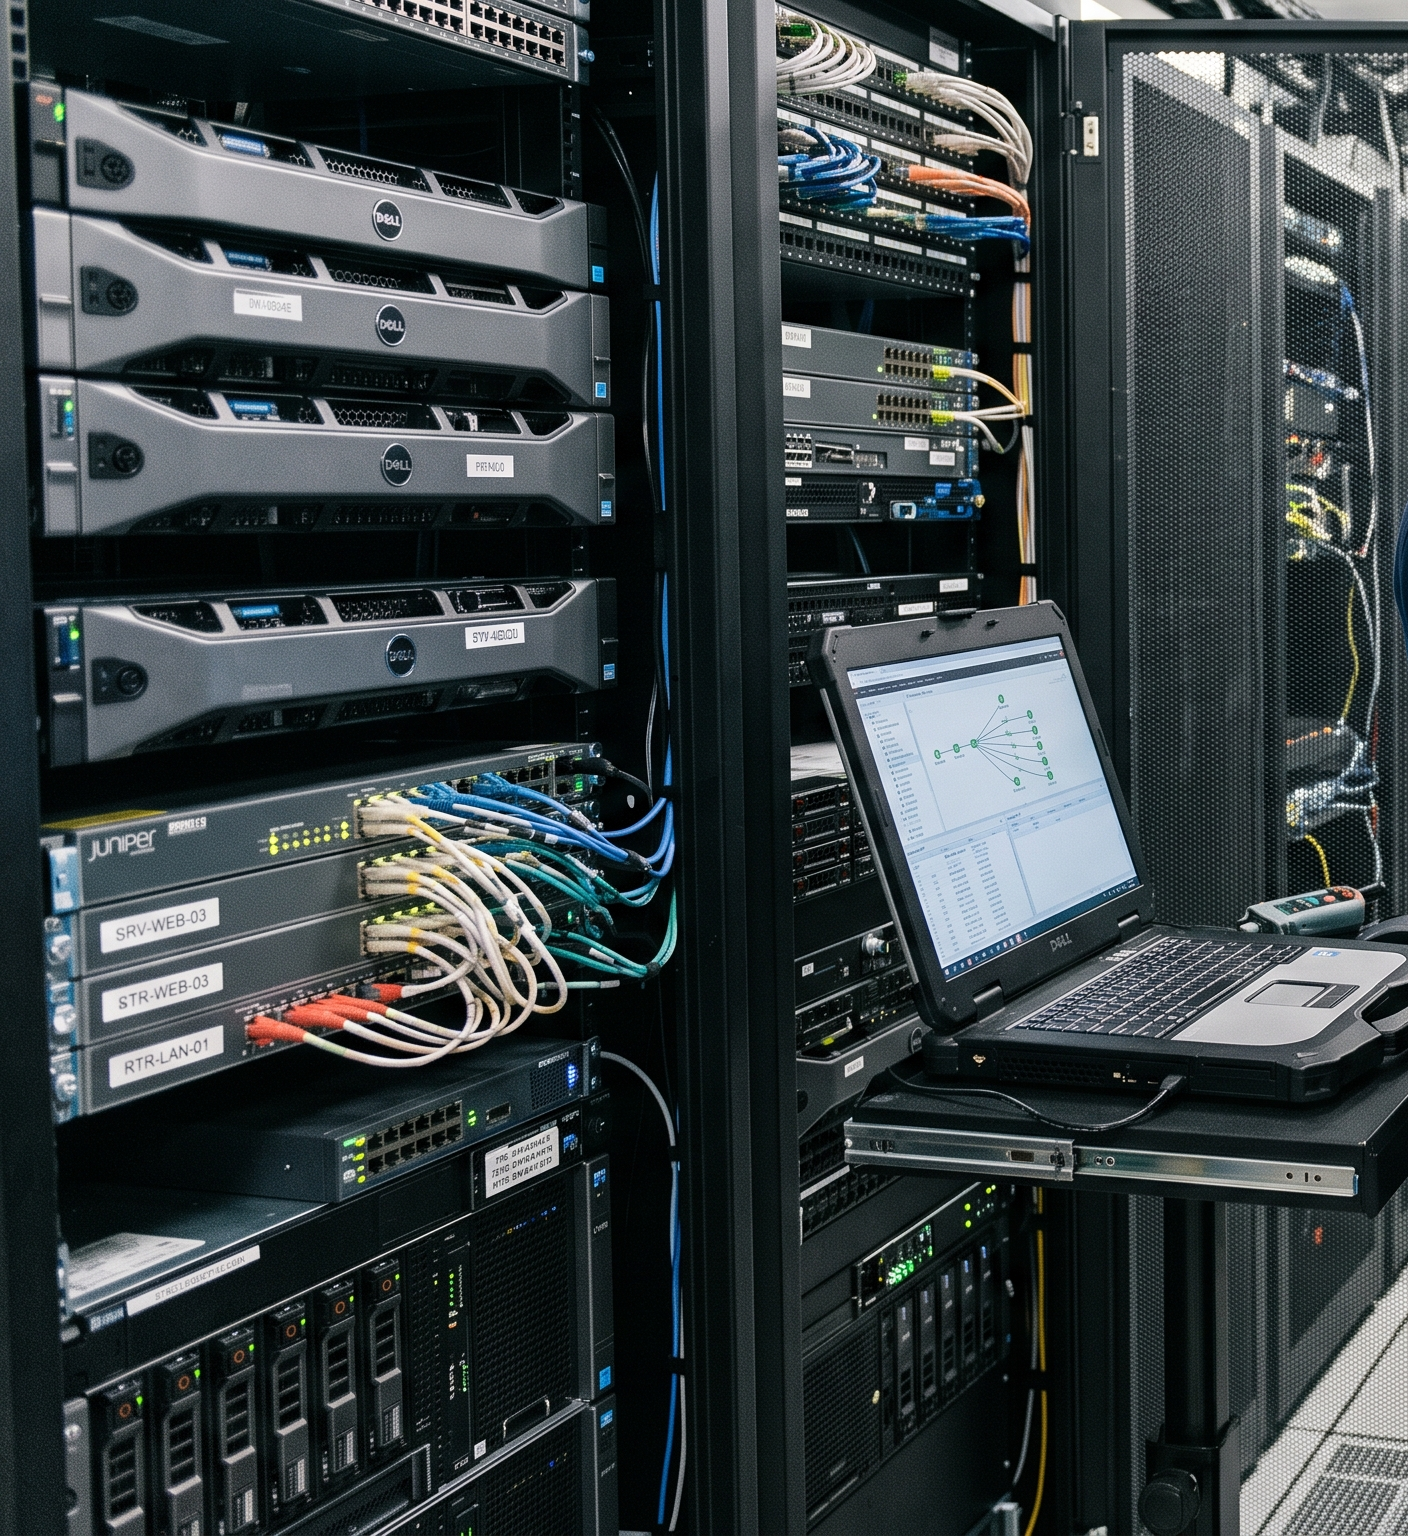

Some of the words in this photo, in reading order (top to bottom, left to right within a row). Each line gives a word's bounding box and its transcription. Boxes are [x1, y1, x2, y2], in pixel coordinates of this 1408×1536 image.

[385, 460, 411, 471] DELL
[116, 908, 207, 941] SRV-WEB-03
[1050, 933, 1073, 952] DELL
[118, 974, 209, 1010] STR-WEB-03
[124, 1038, 209, 1075] RTR-LAN-01
